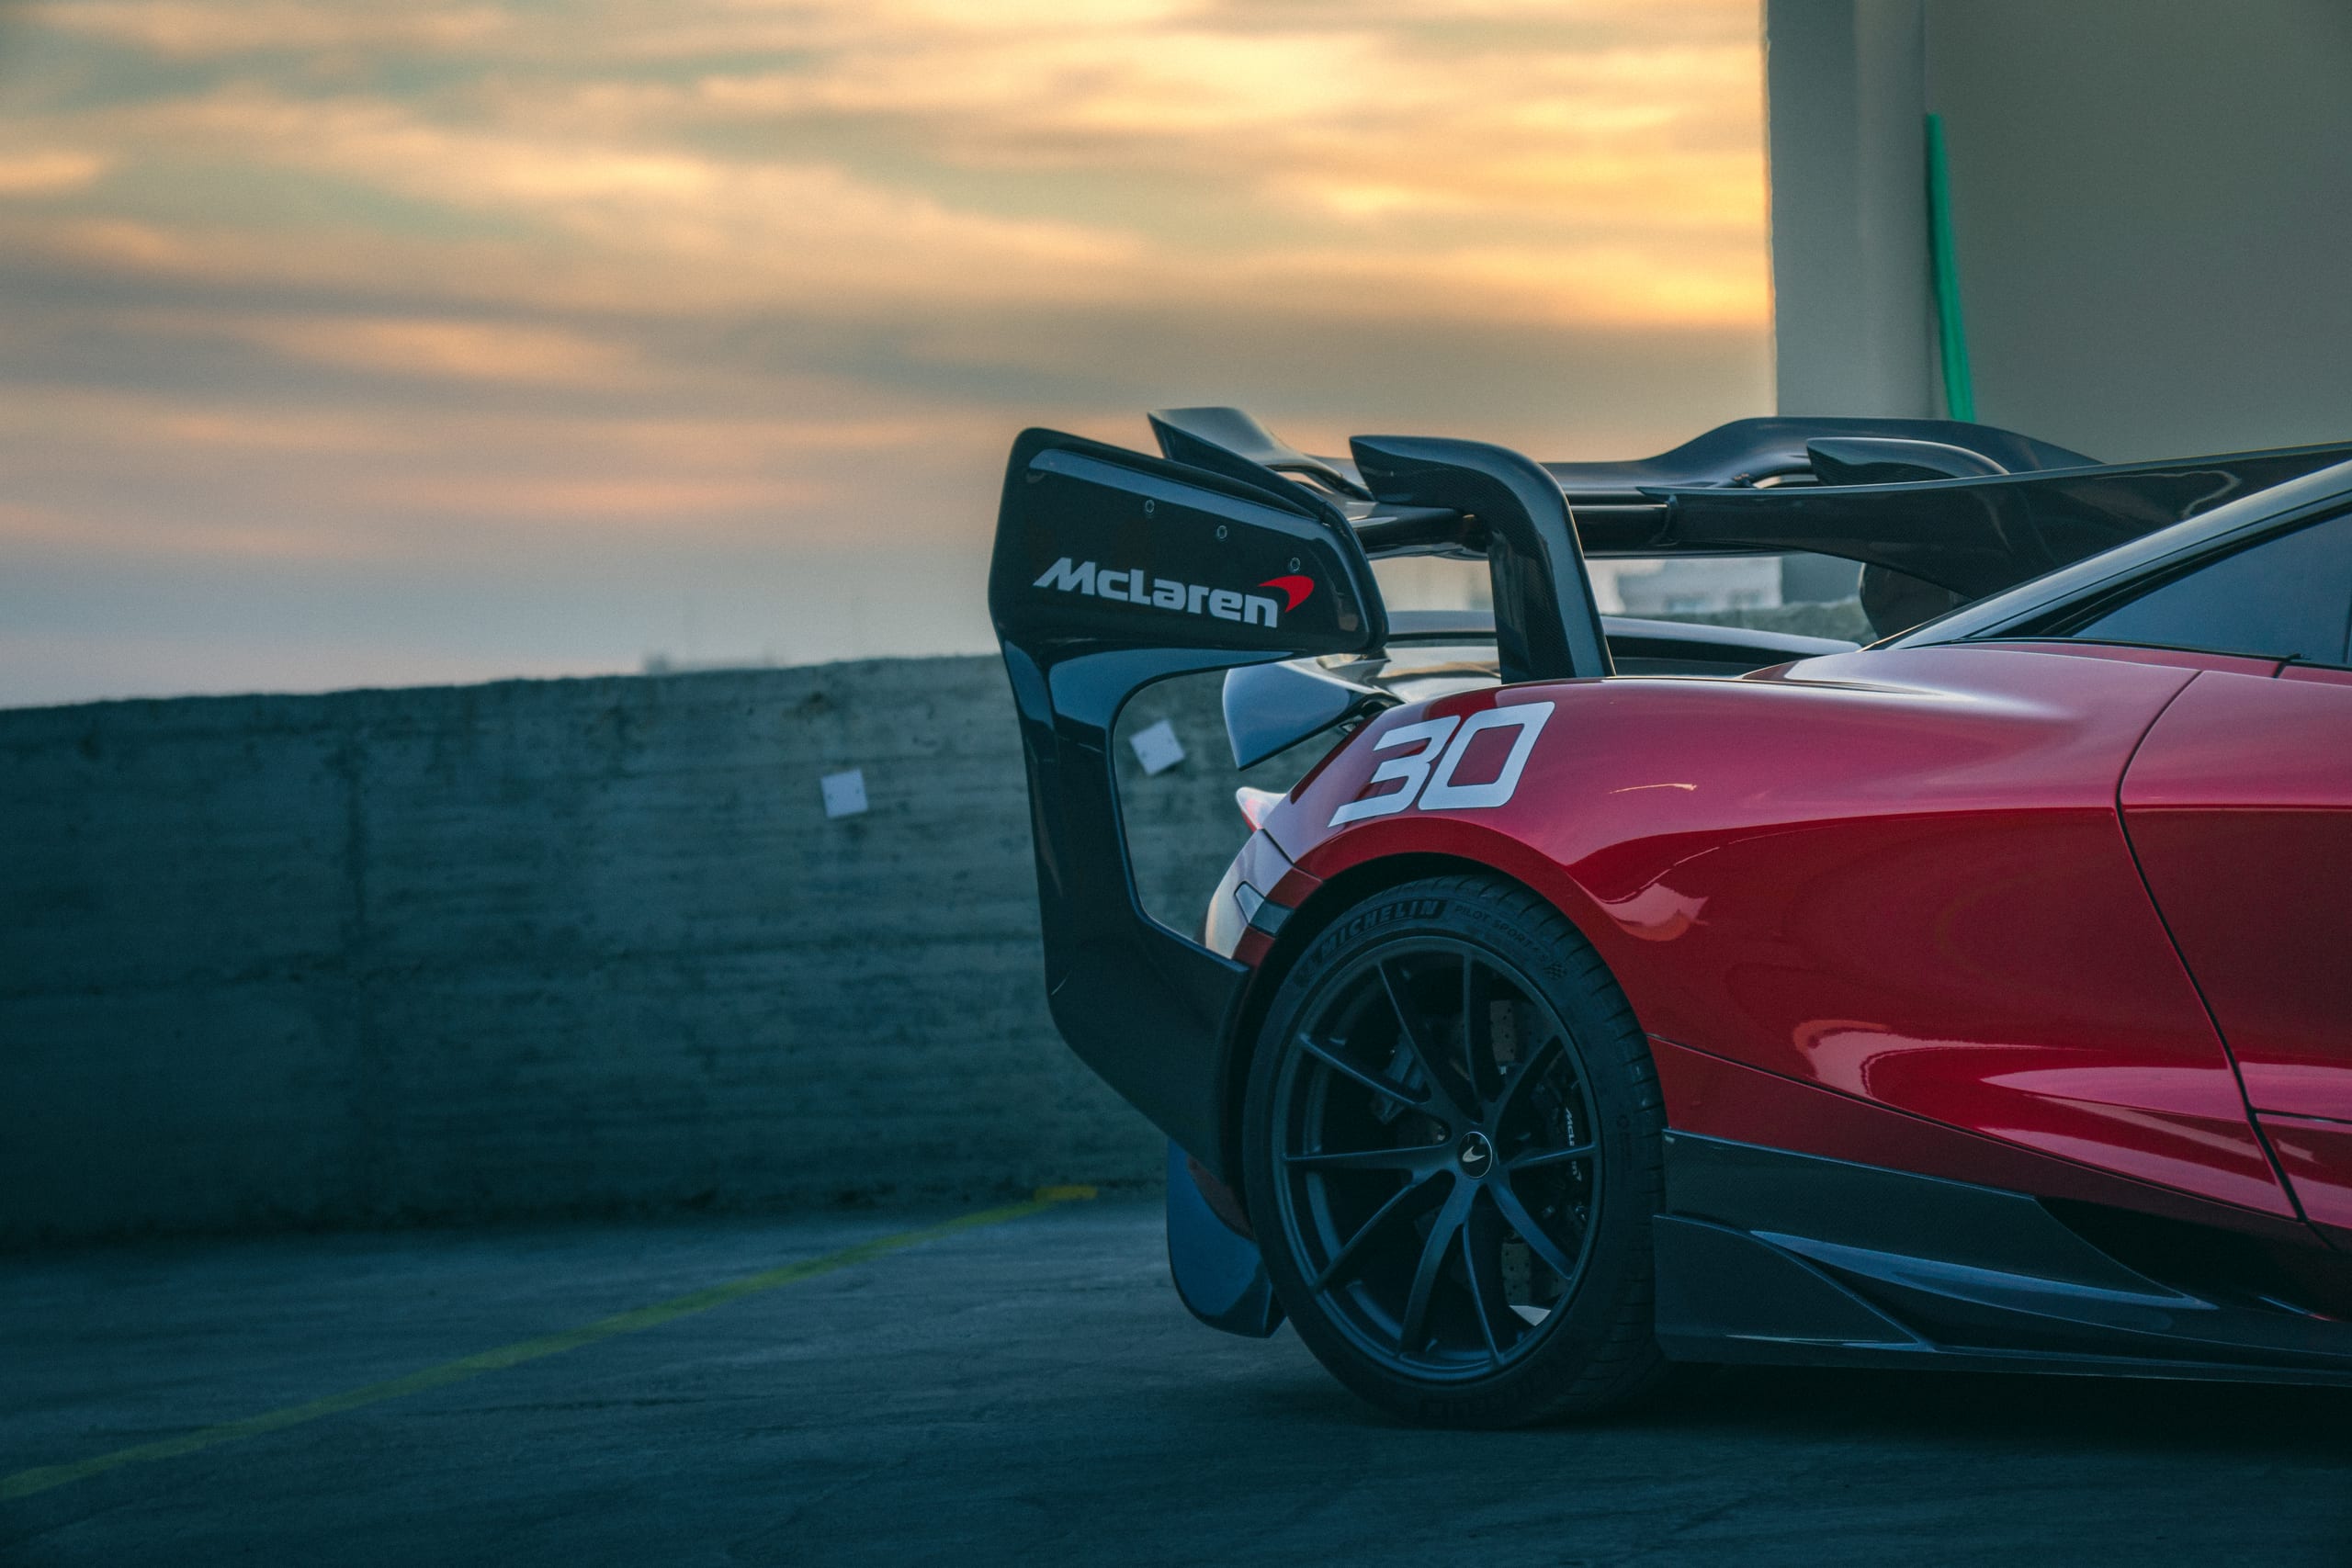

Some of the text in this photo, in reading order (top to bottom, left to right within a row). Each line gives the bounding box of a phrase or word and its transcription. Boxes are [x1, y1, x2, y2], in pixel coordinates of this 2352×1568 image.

[1033, 556, 1278, 629] McLaren
[1328, 701, 1555, 828] 30
[1319, 899, 1441, 956] MICHELIN
[1454, 905, 1533, 947] PILOT SPORT
